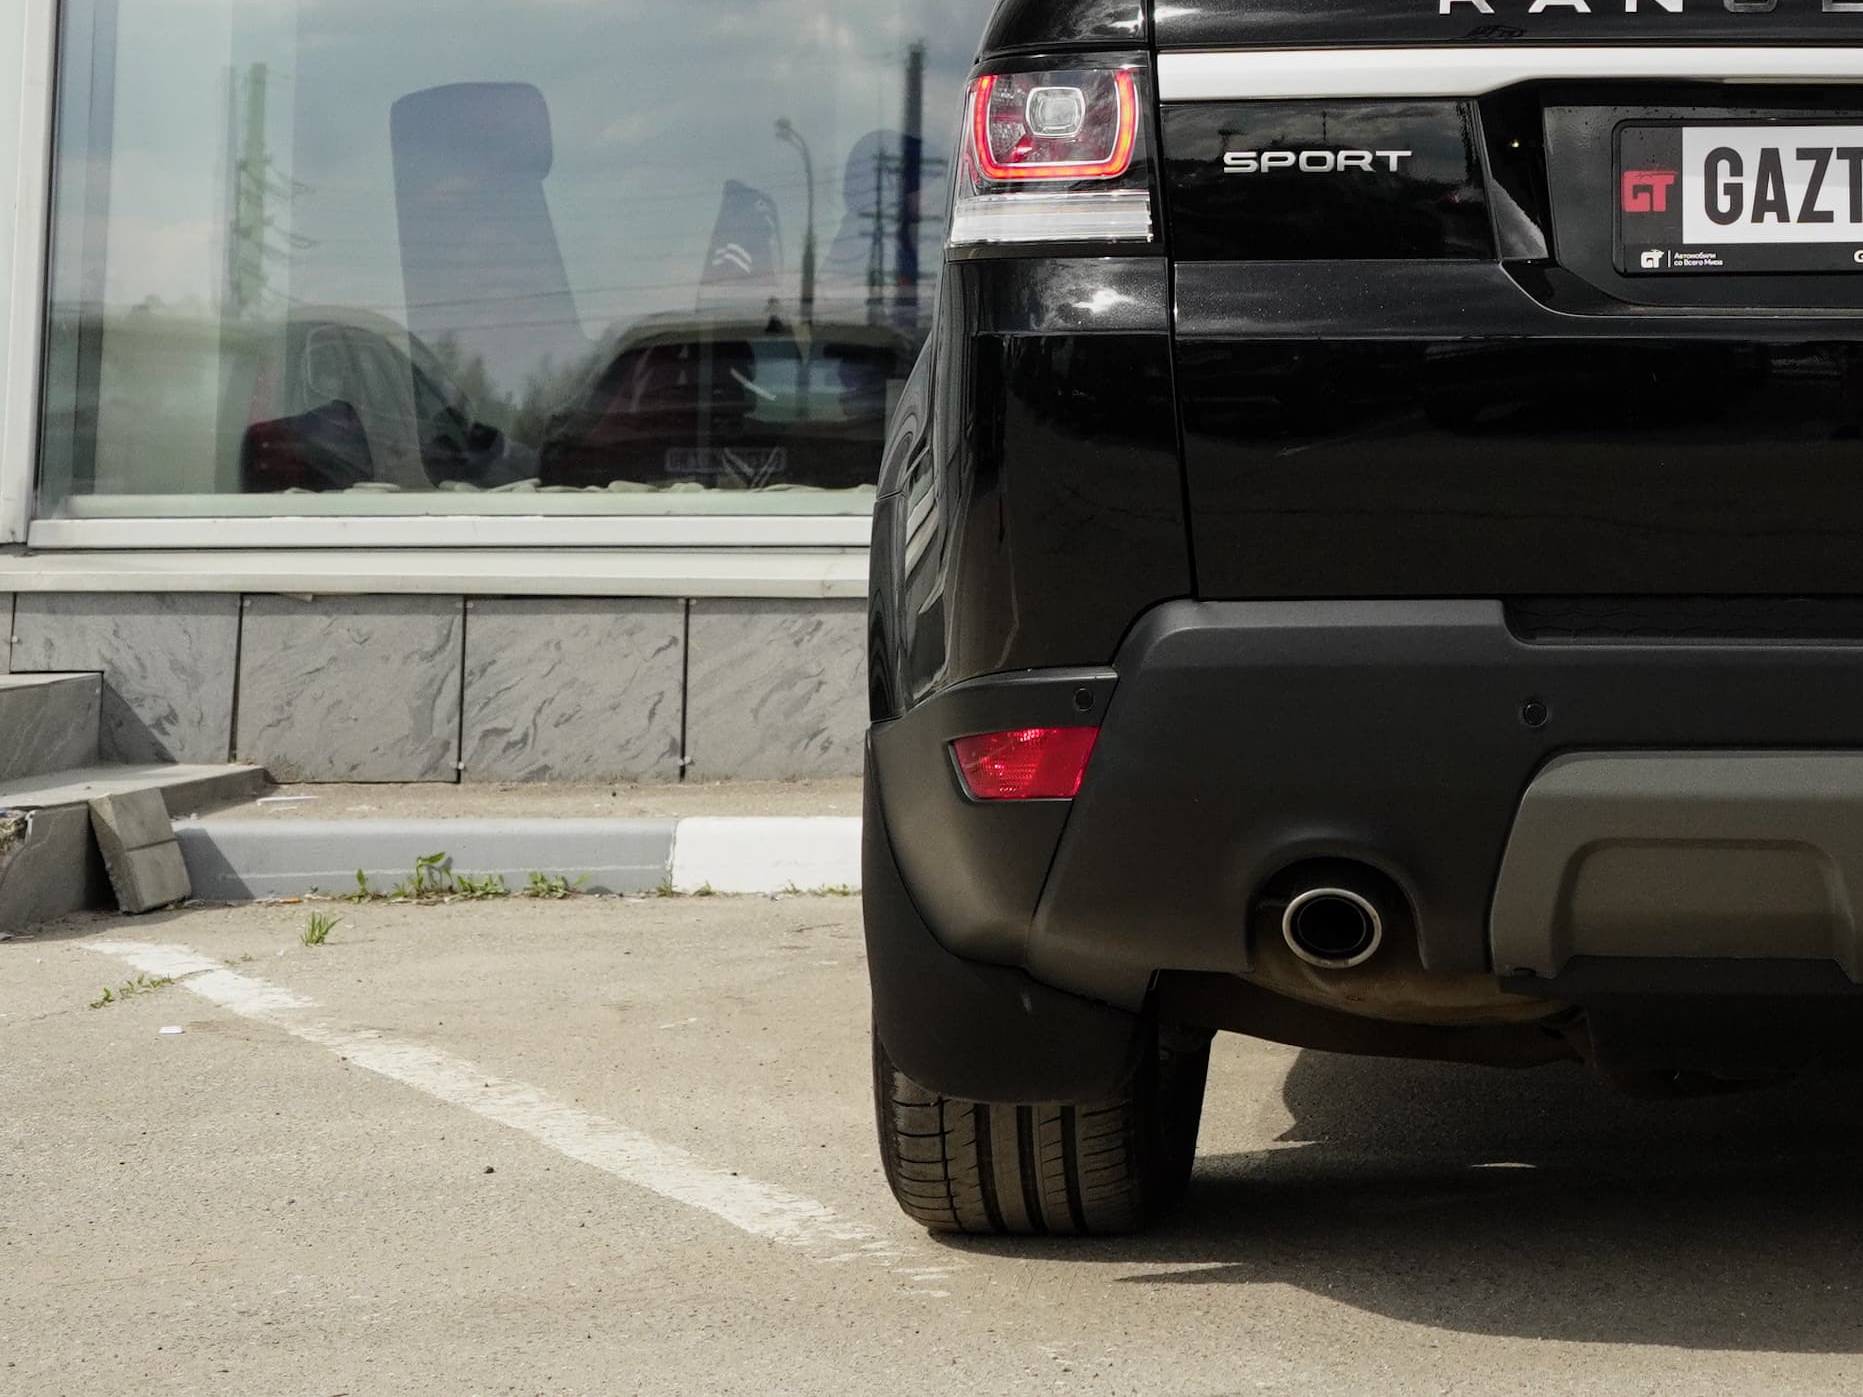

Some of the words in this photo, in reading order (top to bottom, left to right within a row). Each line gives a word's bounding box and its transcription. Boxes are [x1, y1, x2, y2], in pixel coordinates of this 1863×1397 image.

[1222, 149, 1413, 174] SPORT
[1622, 170, 1676, 213] GT
[1640, 249, 1664, 269] GT
